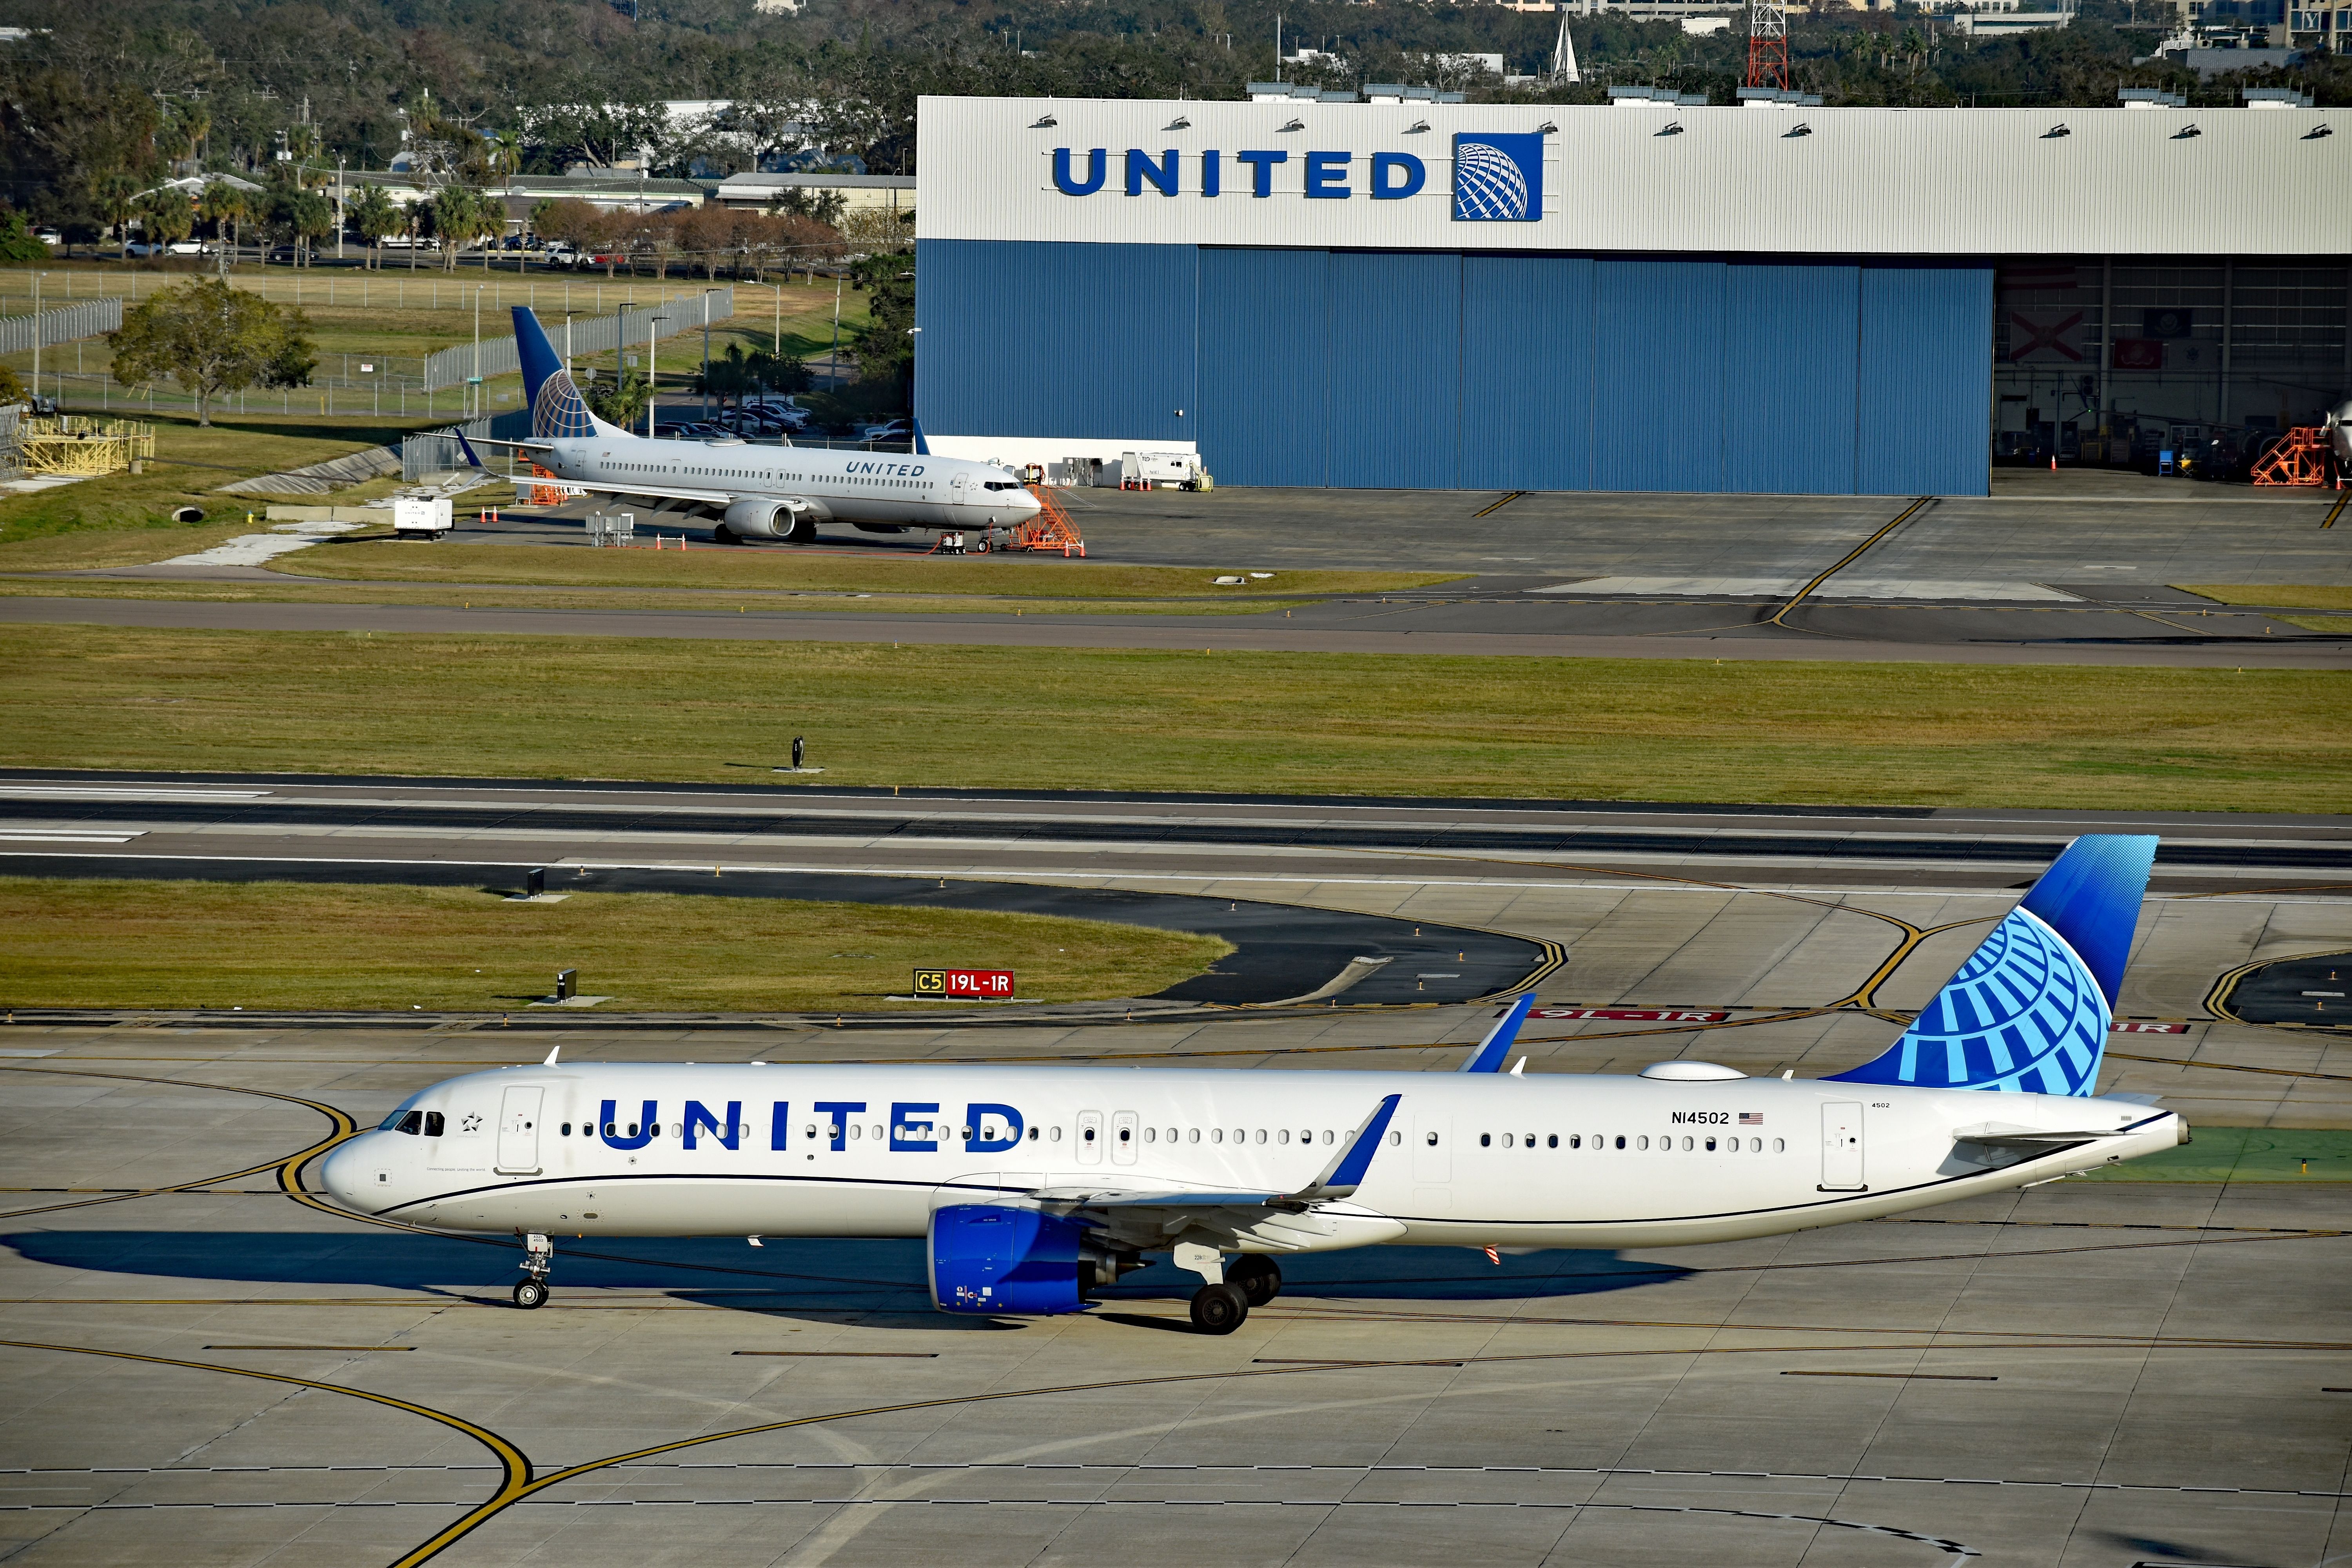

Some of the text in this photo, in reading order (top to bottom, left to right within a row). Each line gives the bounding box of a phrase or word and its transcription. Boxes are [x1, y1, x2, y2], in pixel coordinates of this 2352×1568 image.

[1055, 148, 1426, 199] UNITED
[846, 461, 925, 477] UNITED
[919, 974, 1008, 991] C5 19L-1R
[1527, 1009, 1712, 1021] 9L-1R
[599, 1100, 1024, 1152] UNITED
[1672, 1112, 1729, 1124] N14502
